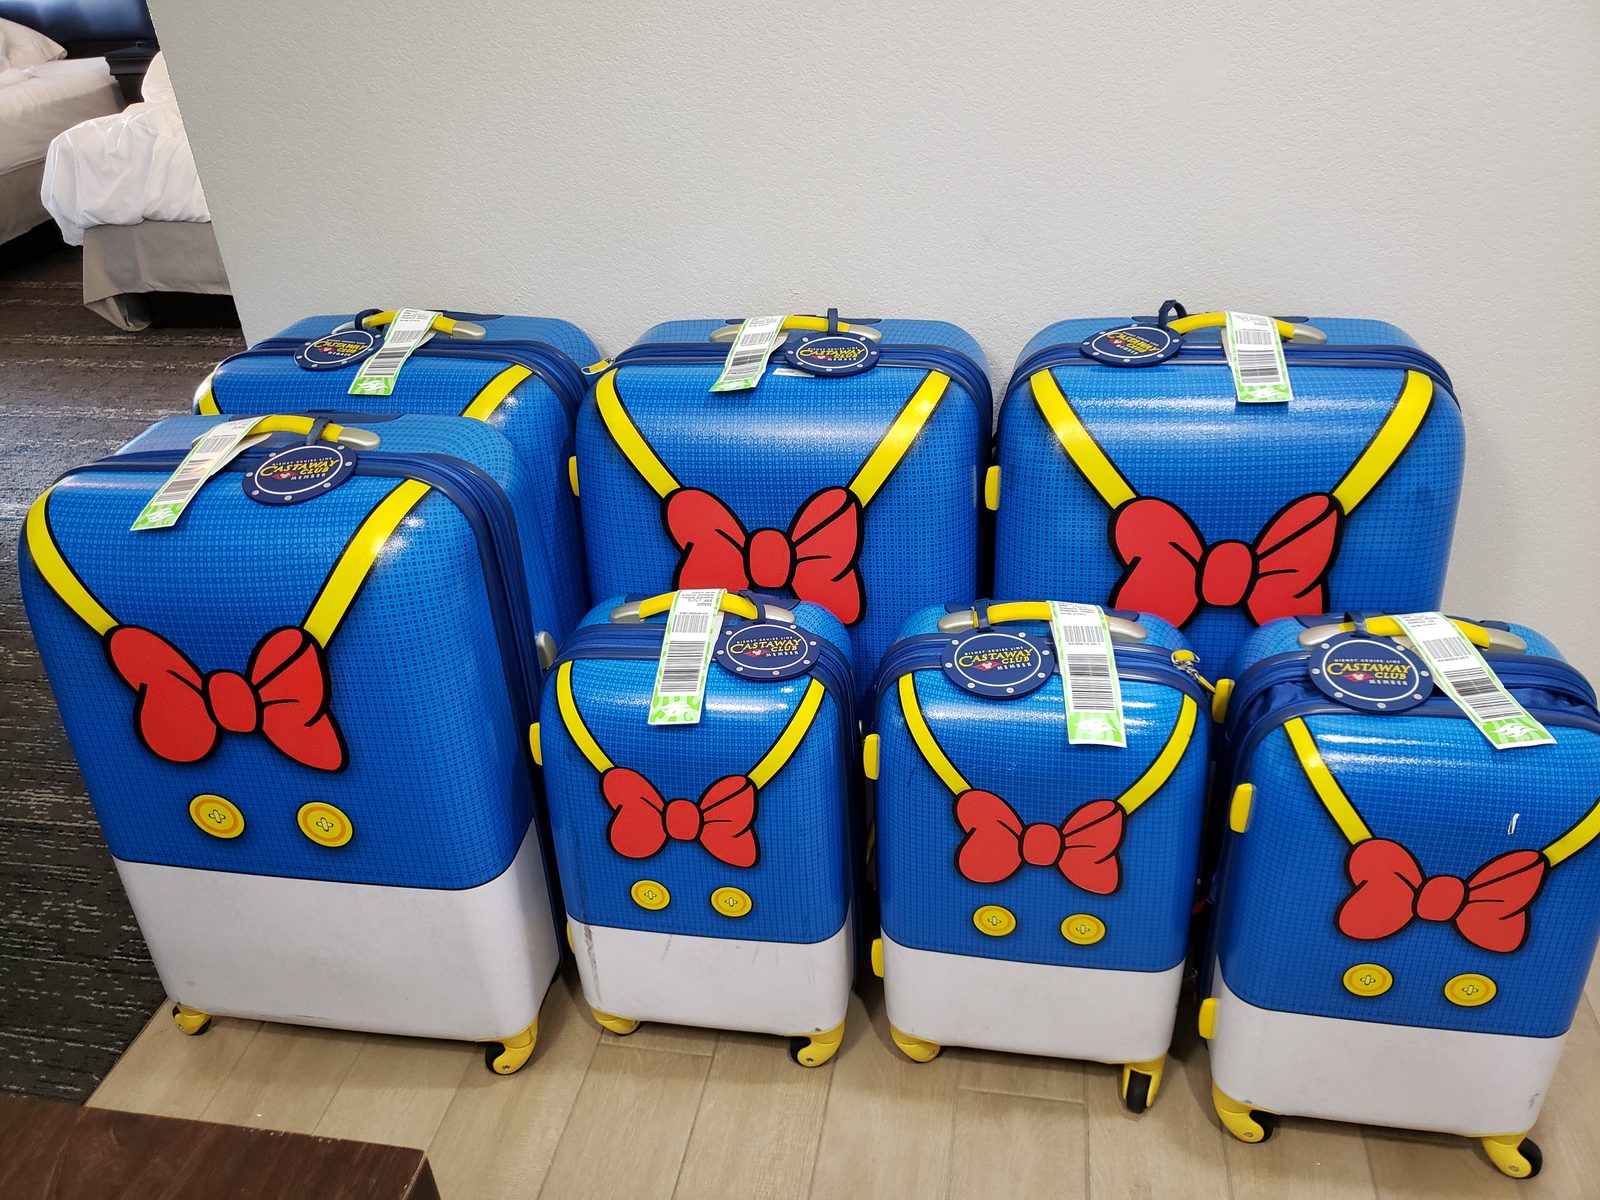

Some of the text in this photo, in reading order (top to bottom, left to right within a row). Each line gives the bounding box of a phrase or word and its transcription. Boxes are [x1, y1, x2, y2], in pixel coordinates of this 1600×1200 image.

[799, 348, 865, 356] CASTAWAY
[260, 459, 340, 476] CASTAWAY
[300, 466, 329, 475] CLUB
[730, 639, 802, 654] CASTAWAY
[958, 648, 1034, 667] CASTAWAY
[1001, 655, 1030, 664] CLUB
[996, 662, 1032, 670] MEMBER
[1327, 662, 1412, 676] CASTAWAY
[1374, 672, 1407, 680] CLUB
